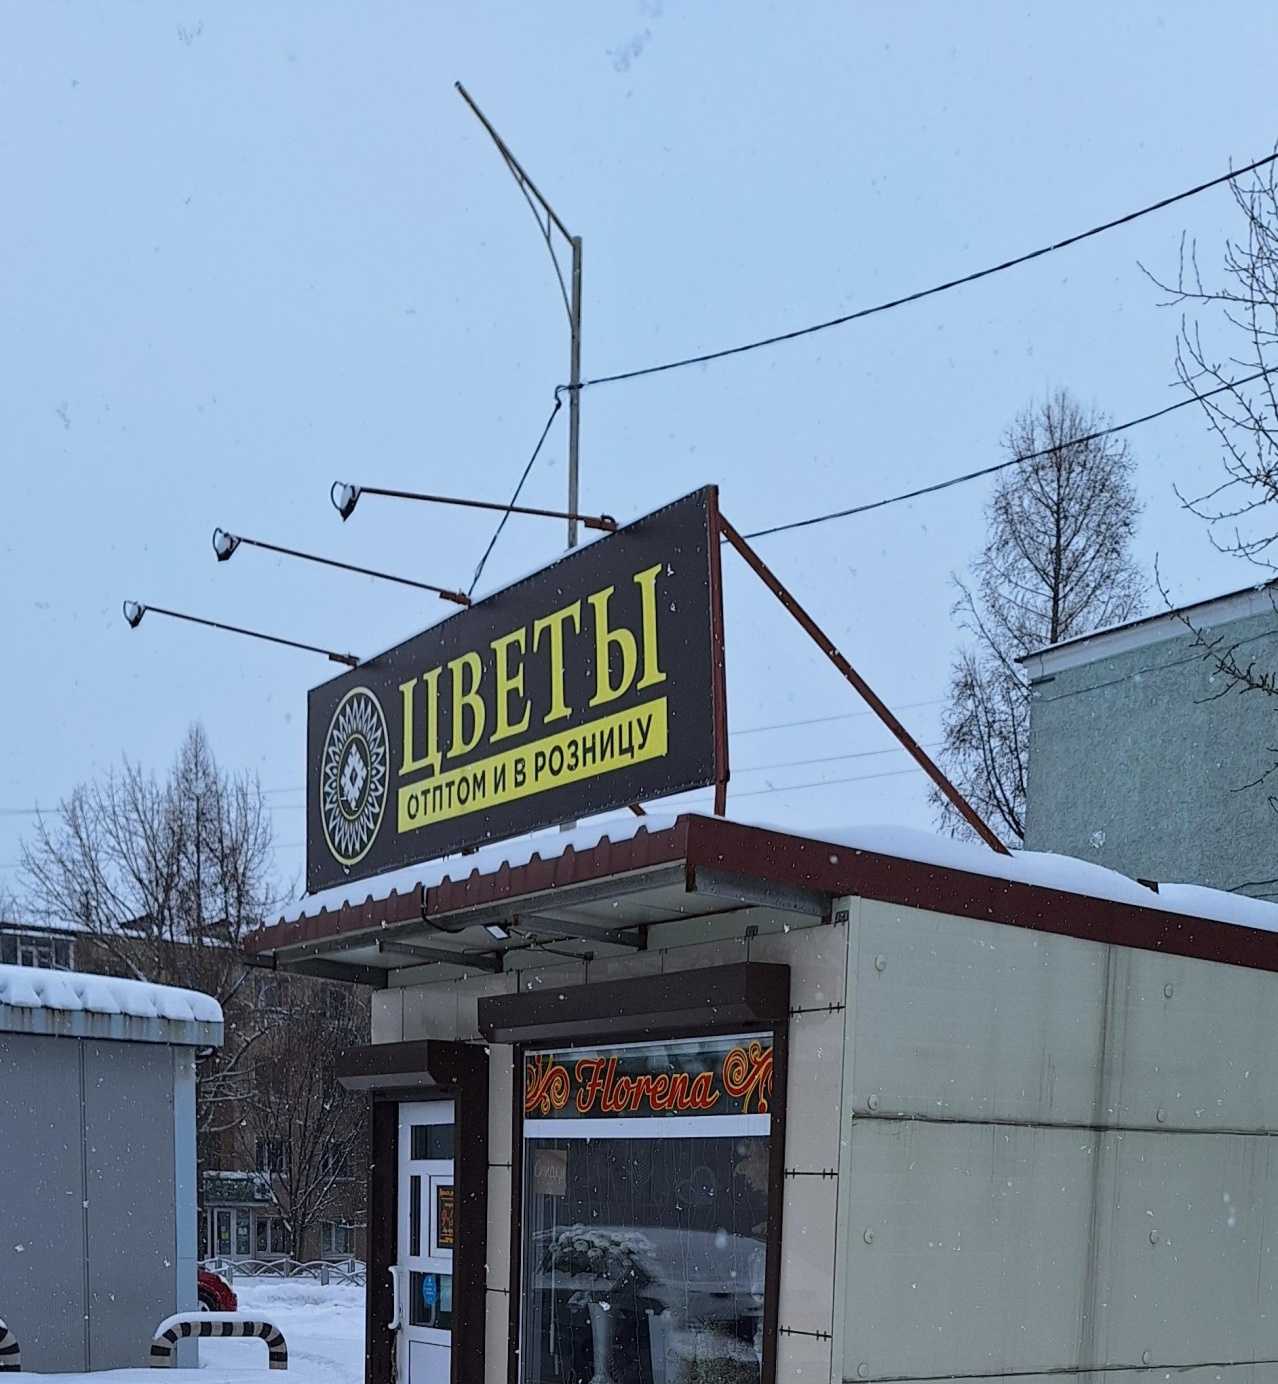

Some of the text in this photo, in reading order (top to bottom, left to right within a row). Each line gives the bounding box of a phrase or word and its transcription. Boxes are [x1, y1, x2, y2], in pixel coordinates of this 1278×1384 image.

[399, 563, 668, 777] ЦВЕТЫ
[407, 713, 654, 820] ОТПТОМ И В РОЗНИЦУ
[575, 1055, 720, 1113] Florena
